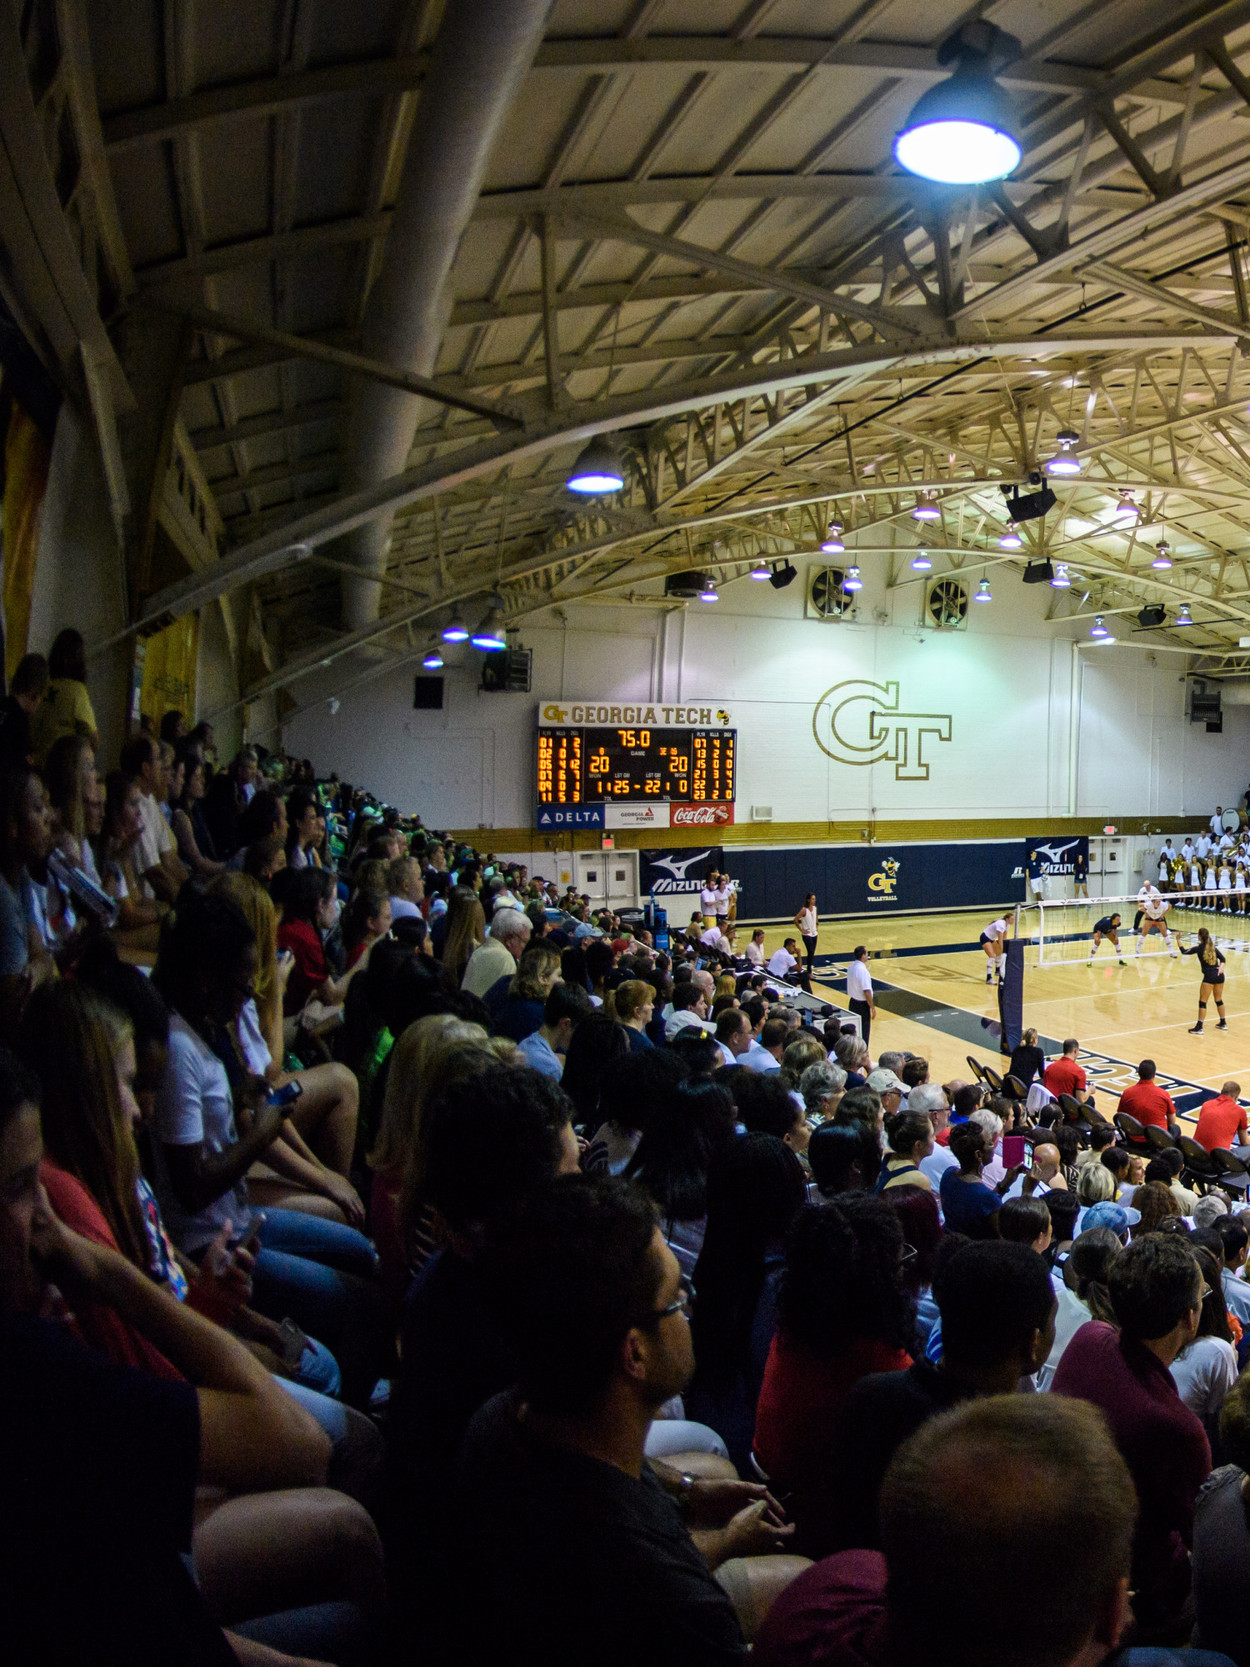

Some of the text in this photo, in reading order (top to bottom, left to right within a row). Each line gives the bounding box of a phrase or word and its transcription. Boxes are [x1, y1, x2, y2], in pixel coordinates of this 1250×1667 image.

[544, 706, 712, 724] GT GEORGIA TECH
[812, 679, 952, 781] GT
[539, 737, 580, 748] 01 1 2
[694, 738, 733, 748] 07 4 1
[539, 748, 580, 759] 02 0 7
[696, 749, 733, 758] 13 2 4
[539, 759, 580, 770] 05 4 12
[590, 756, 610, 773] 20
[669, 756, 688, 772] 20
[696, 759, 733, 769] 15 0 0
[539, 770, 580, 780] 07 6 7
[694, 769, 732, 779] 21 3 4
[539, 780, 580, 791] 09 0 1
[597, 781, 602, 793] 1
[613, 780, 629, 793] 25
[645, 780, 661, 793] 22
[679, 780, 687, 793] 0
[694, 779, 732, 789] 22 1 7
[542, 791, 580, 802] 11 5 3
[694, 790, 732, 800] 23 2 0
[556, 812, 600, 822] DELTA
[674, 807, 715, 824] Coca-Cola
[1040, 862, 1074, 873] MIZUN
[868, 873, 896, 893] GT
